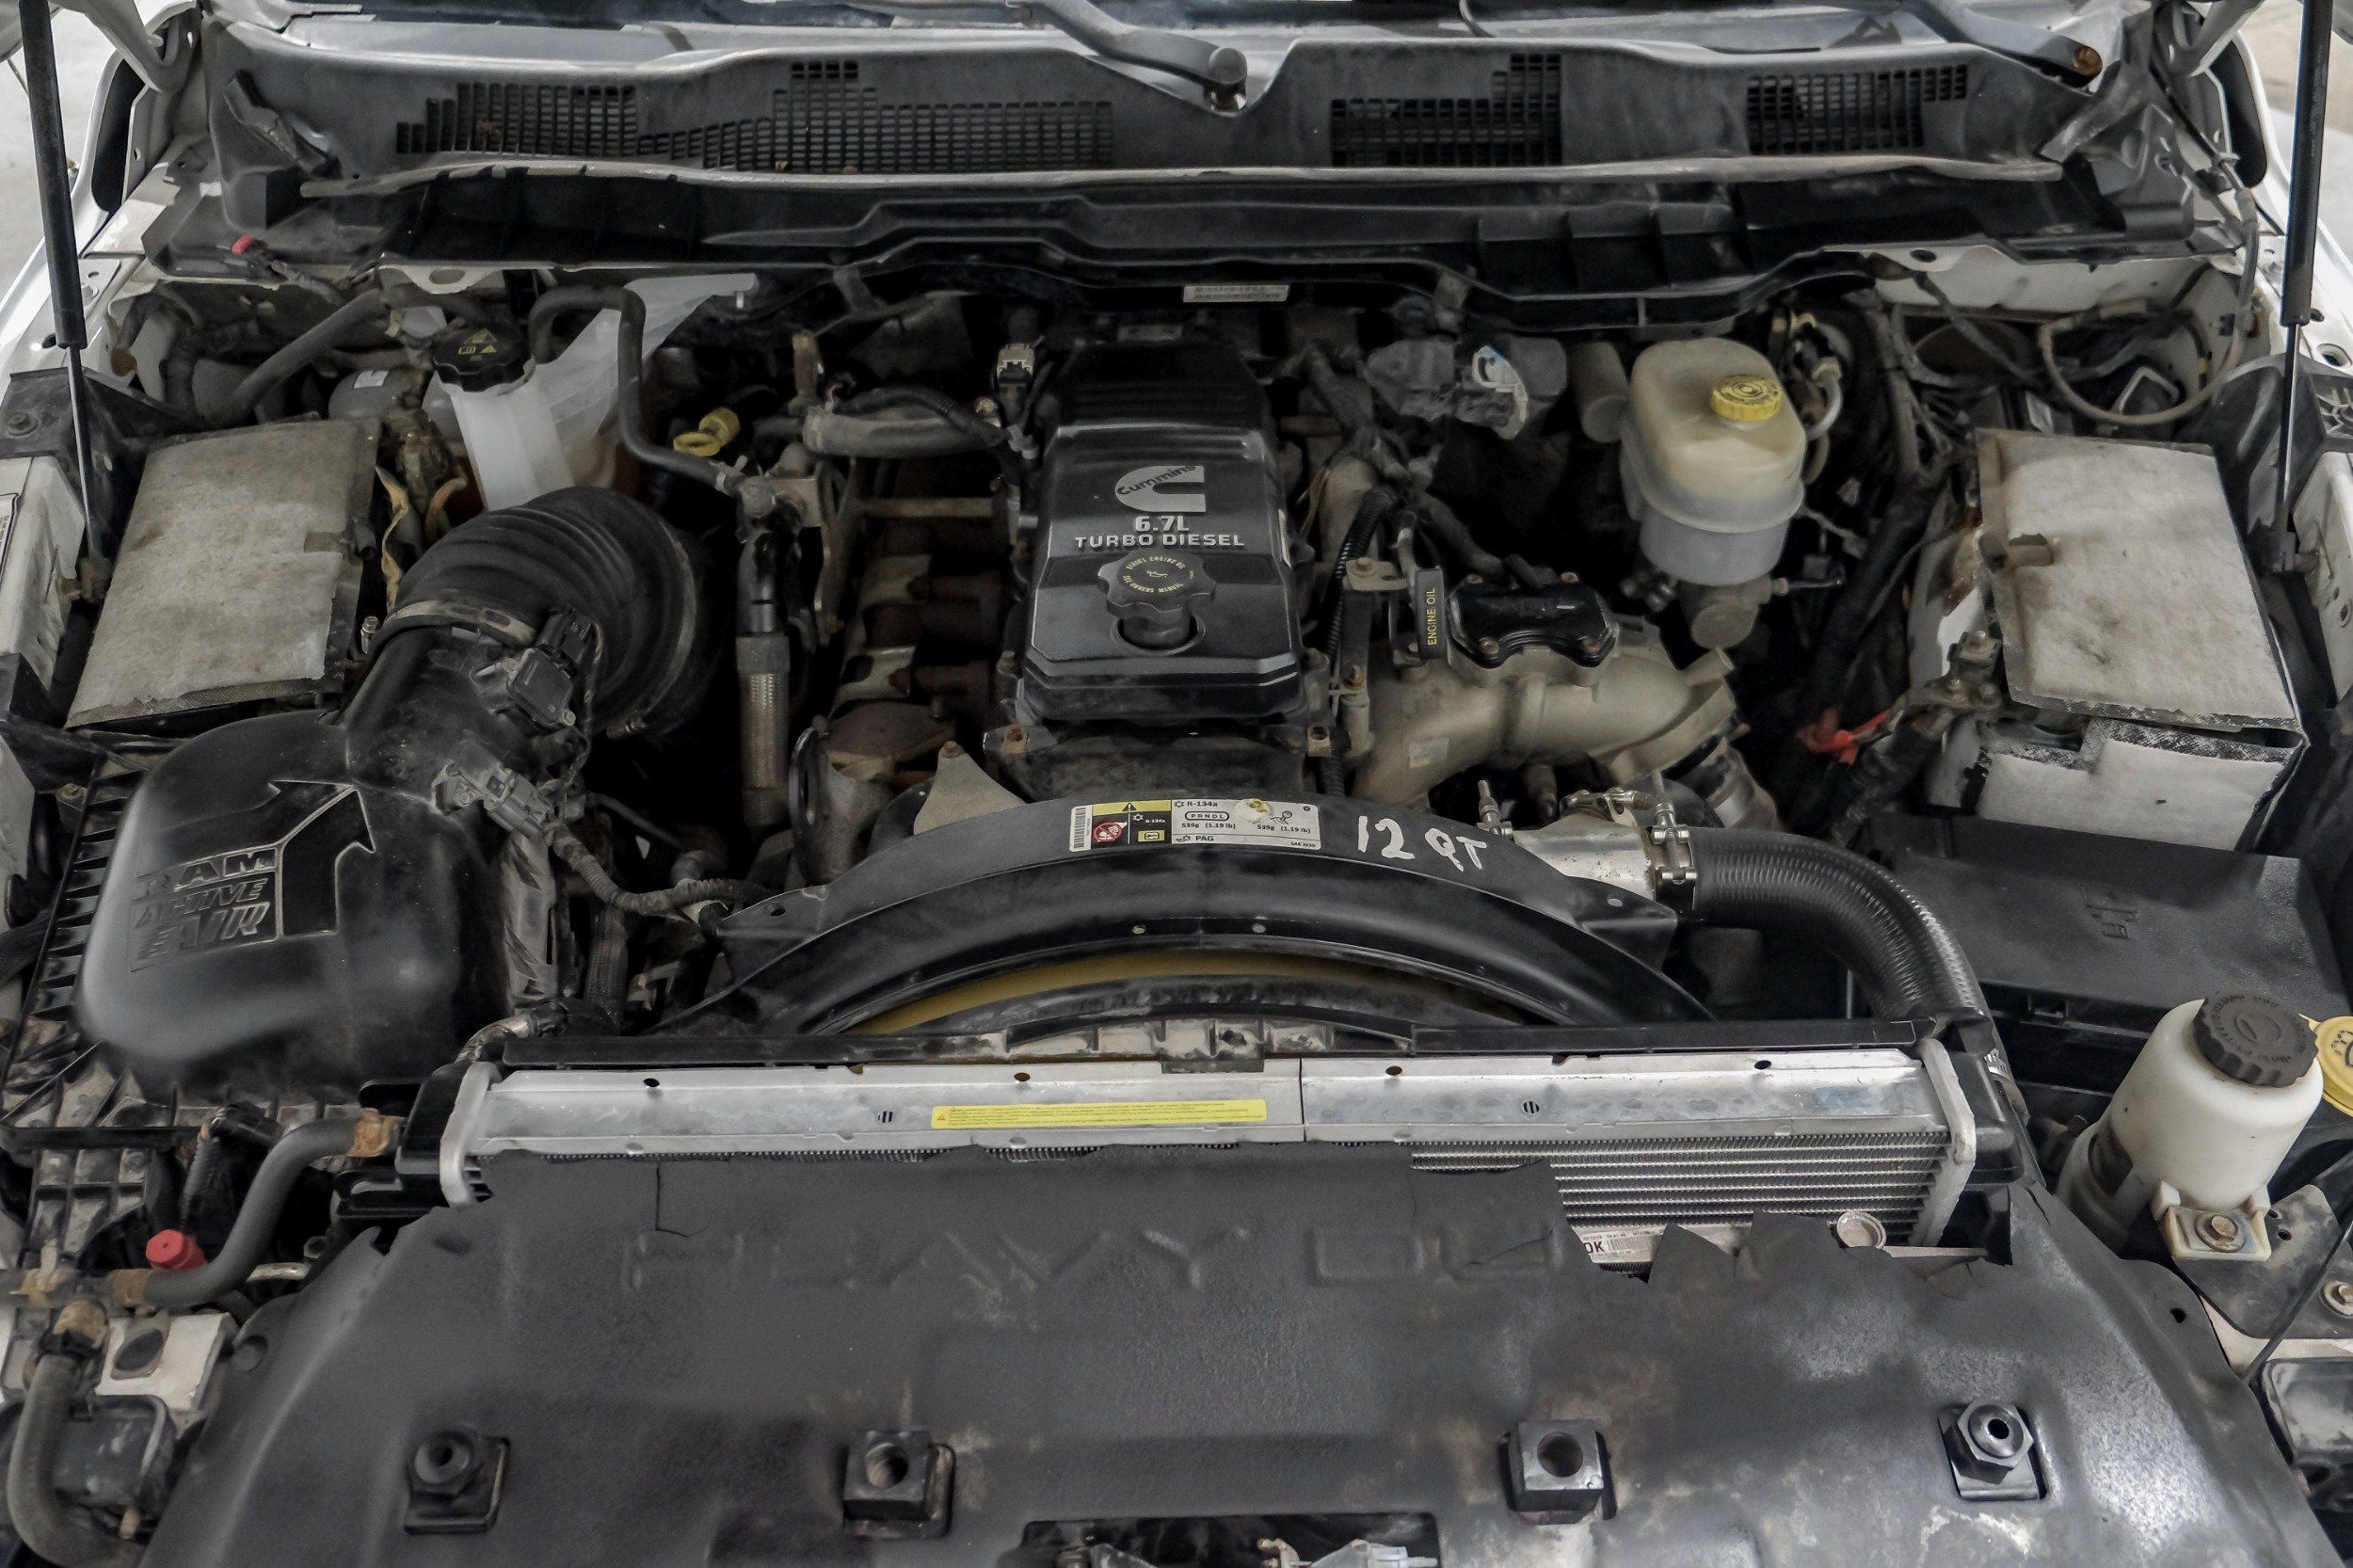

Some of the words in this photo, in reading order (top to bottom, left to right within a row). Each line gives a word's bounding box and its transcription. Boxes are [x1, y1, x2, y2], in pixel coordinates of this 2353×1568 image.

[1117, 466, 1196, 495] Cummins
[1135, 516, 1190, 533] 6.7L
[1075, 534, 1154, 549] TURBO
[1162, 534, 1245, 547] DIESEL
[1427, 587, 1435, 605] OIL
[1428, 605, 1437, 646] ENGINE
[1357, 815, 1416, 860] 12
[1424, 827, 1487, 872] QT
[134, 849, 276, 902] RAM
[1584, 1241, 1605, 1254] OK
